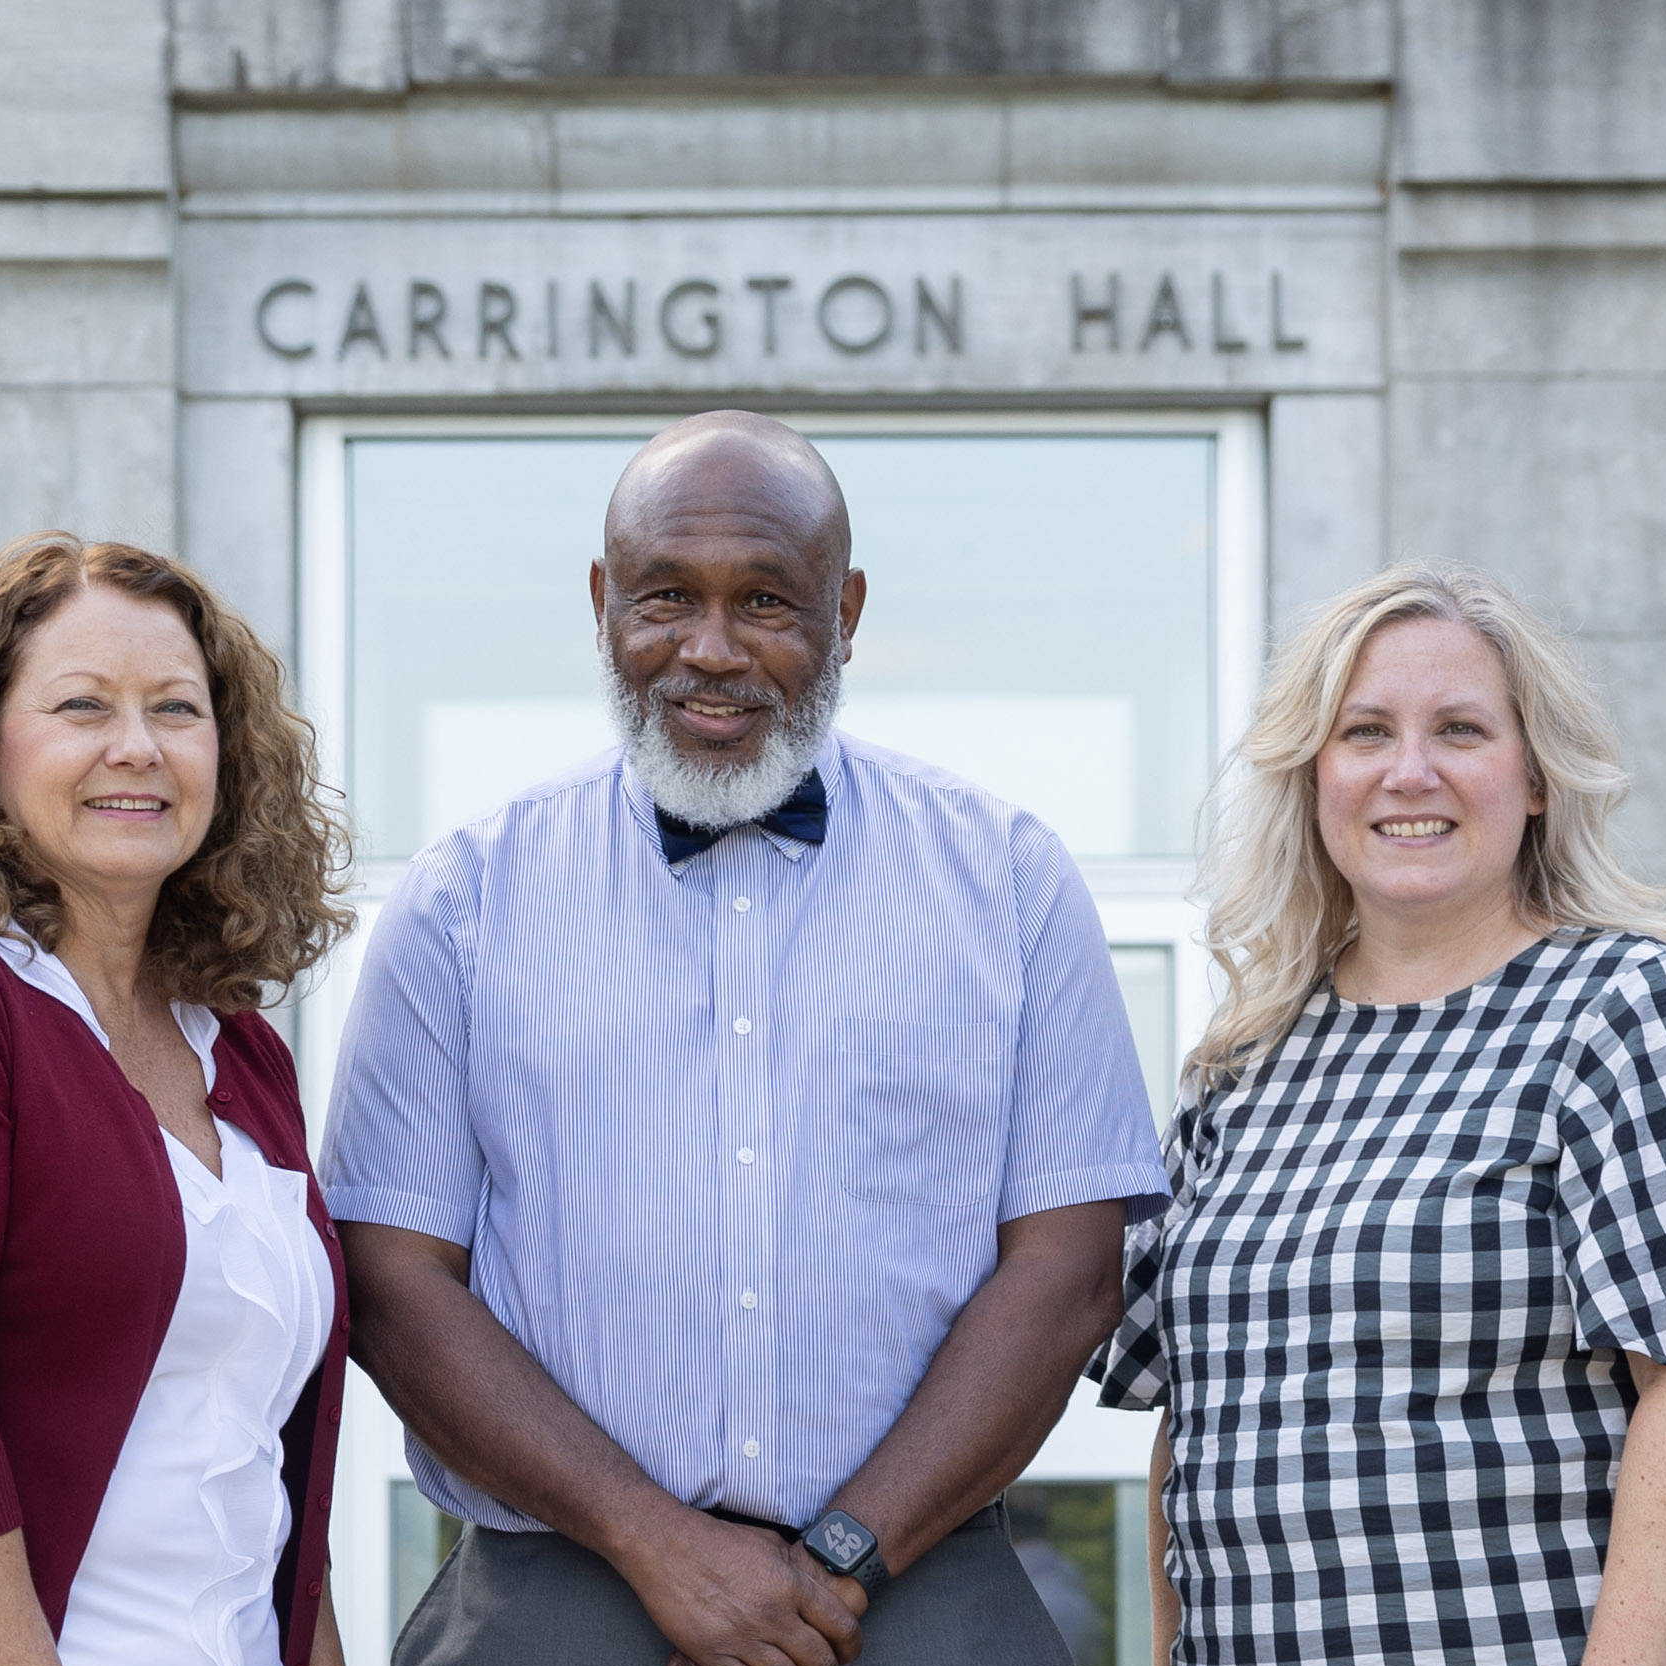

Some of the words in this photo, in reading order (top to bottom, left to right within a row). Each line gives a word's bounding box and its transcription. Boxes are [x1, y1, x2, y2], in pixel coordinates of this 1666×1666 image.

[255, 274, 963, 361] CARRINGTON
[1070, 269, 1307, 355] HALL
[824, 1521, 845, 1551] 47
[835, 1533, 862, 1560] 04
